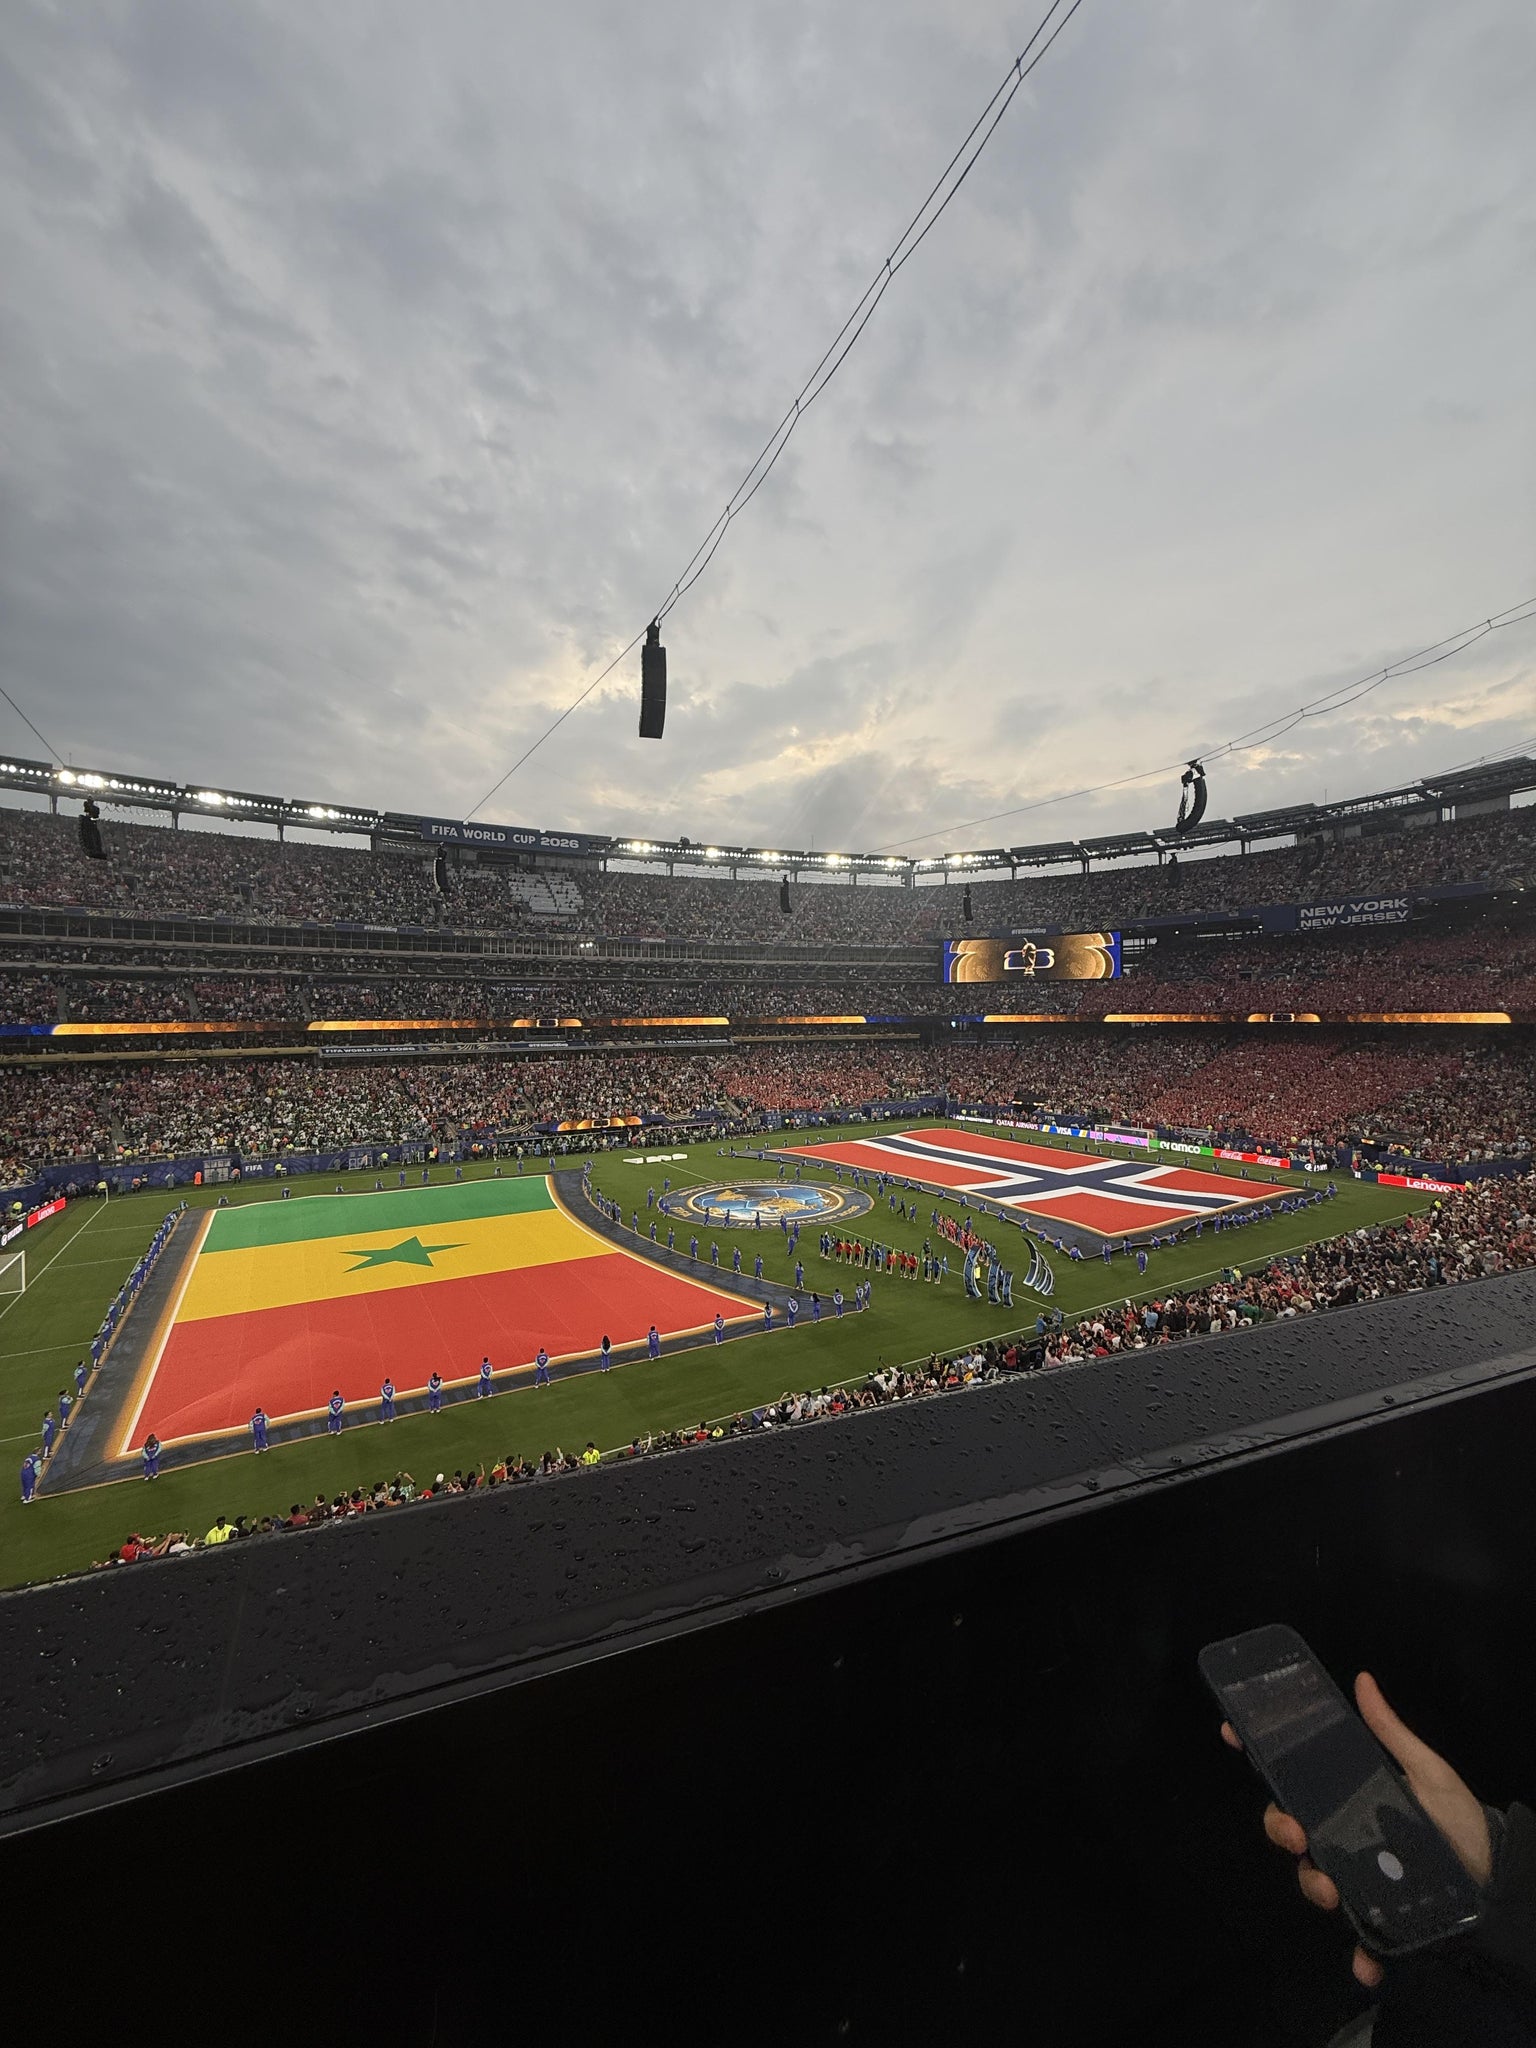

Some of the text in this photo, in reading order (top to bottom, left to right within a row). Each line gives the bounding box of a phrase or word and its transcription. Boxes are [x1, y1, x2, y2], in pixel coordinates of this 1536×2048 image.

[431, 825, 580, 849] FIFA WORLD CUP 2026
[1300, 897, 1409, 918] NEW YORK
[1300, 910, 1409, 928] NEW JERSEY
[996, 1119, 1039, 1130] QATAR AIRWAYS
[1056, 1126, 1073, 1136] VISA
[1160, 1141, 1201, 1154] aramco
[245, 1164, 263, 1172] FIFA
[1406, 1177, 1452, 1193] Lenovo
